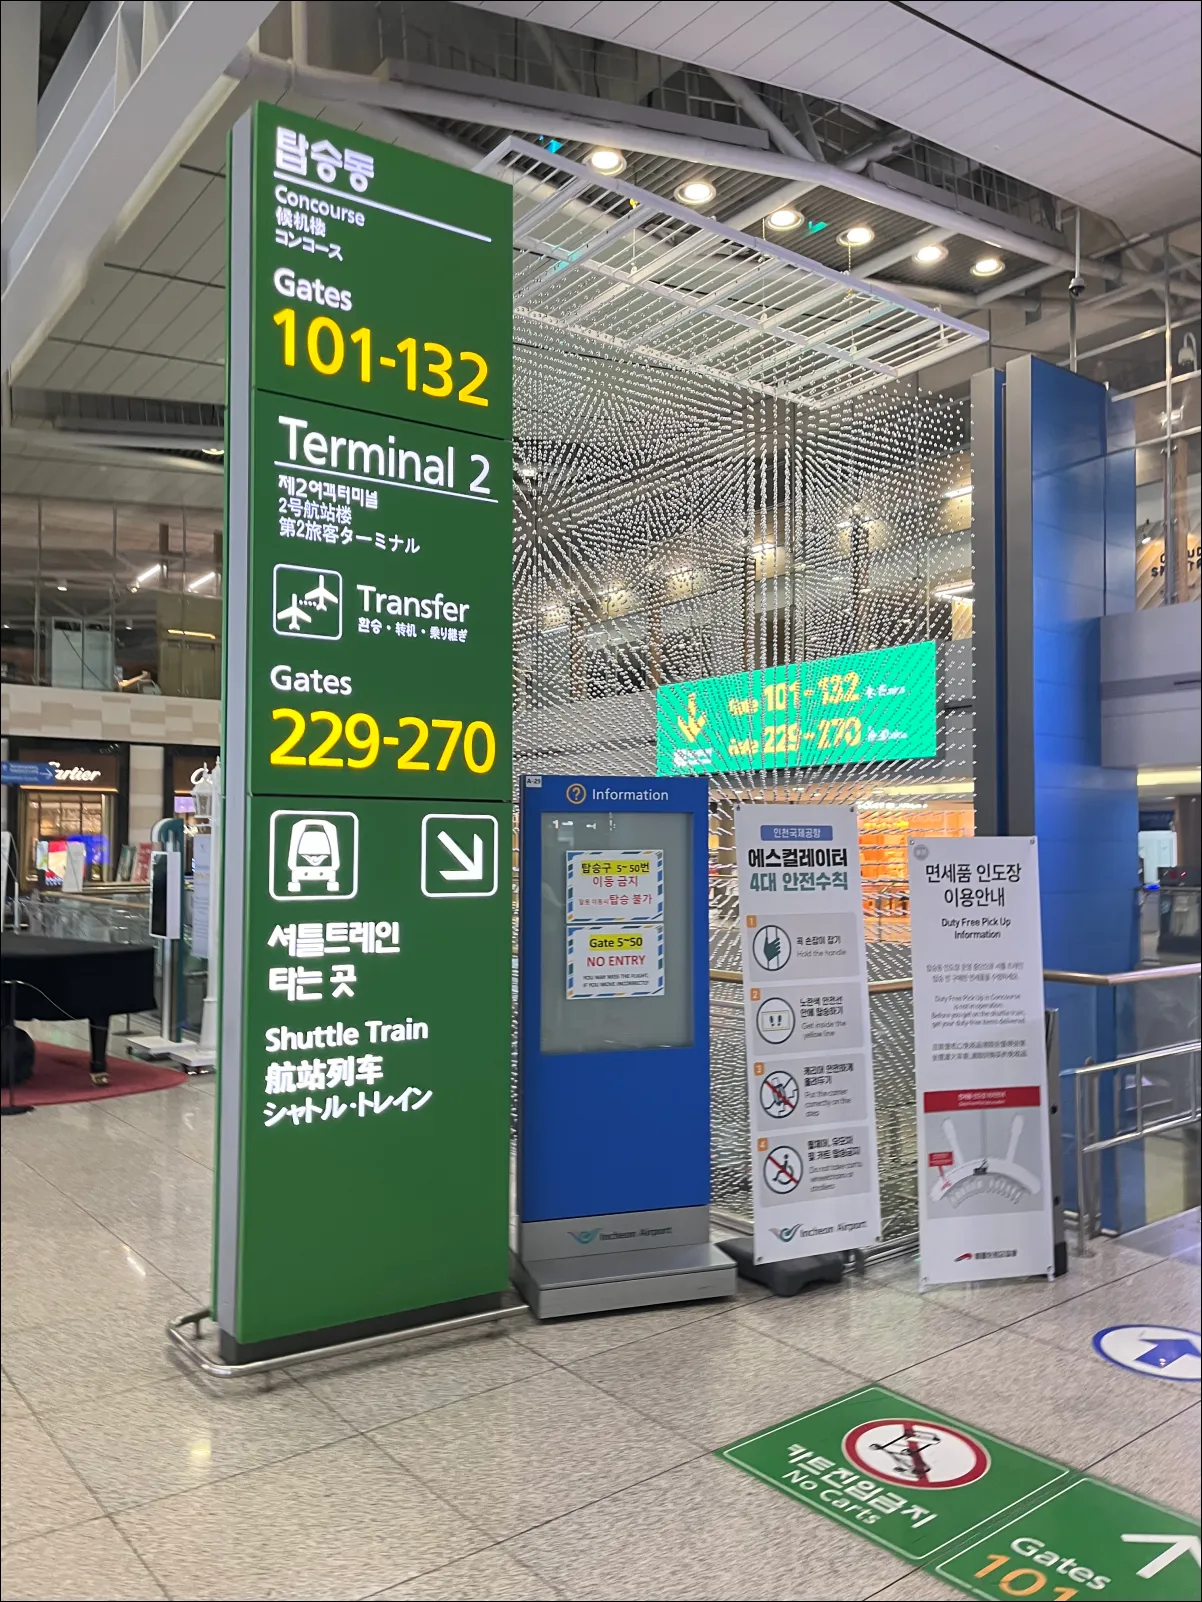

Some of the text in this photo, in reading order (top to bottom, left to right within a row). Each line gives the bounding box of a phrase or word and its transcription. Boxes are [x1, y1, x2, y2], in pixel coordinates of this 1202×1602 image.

[276, 126, 374, 192] 탑승동
[274, 184, 365, 227] Concourse
[275, 229, 343, 261] コンコース
[273, 267, 352, 311] Gates
[273, 308, 489, 407] 101-132
[278, 416, 490, 495] Terminal 2
[278, 475, 378, 509] 제2여객터미널
[279, 498, 352, 525] 2号航站楼
[279, 517, 420, 554] 第2旅客ターミナル
[357, 584, 470, 622] Transfer
[270, 664, 352, 696] Gates
[270, 708, 496, 774] 229-270
[592, 788, 669, 801] Information
[773, 828, 821, 838] 인천국제공항
[581, 862, 611, 874] 탑승구
[748, 848, 847, 868] 에스컬레이터
[592, 875, 639, 888] 이동 금지
[750, 871, 848, 892] 4대 안전수칙
[926, 863, 1022, 883] 면세품 인도장
[609, 894, 629, 906] 탑승
[633, 894, 652, 905] 불가
[944, 887, 1005, 908] 이용안내
[942, 917, 1011, 928] Duty Free Pick Up
[954, 930, 1001, 939] Information
[267, 921, 400, 957] 셔틀트레인
[589, 938, 614, 948] Gate
[813, 949, 824, 957] the
[825, 949, 847, 957] handle
[587, 955, 646, 967] NO ENTRY
[268, 964, 357, 1001] 타는 곳
[265, 1017, 428, 1052] Shuttle Train
[801, 1022, 814, 1030] Get
[835, 1019, 847, 1027] the
[264, 1054, 384, 1094] 航站列车
[599, 1226, 672, 1241] Incheon Airport
[800, 1221, 868, 1237] Incheon Airport
[781, 1469, 881, 1524] No Carts
[787, 1443, 938, 1528] 카트진입금지
[1010, 1537, 1112, 1590] Gates
